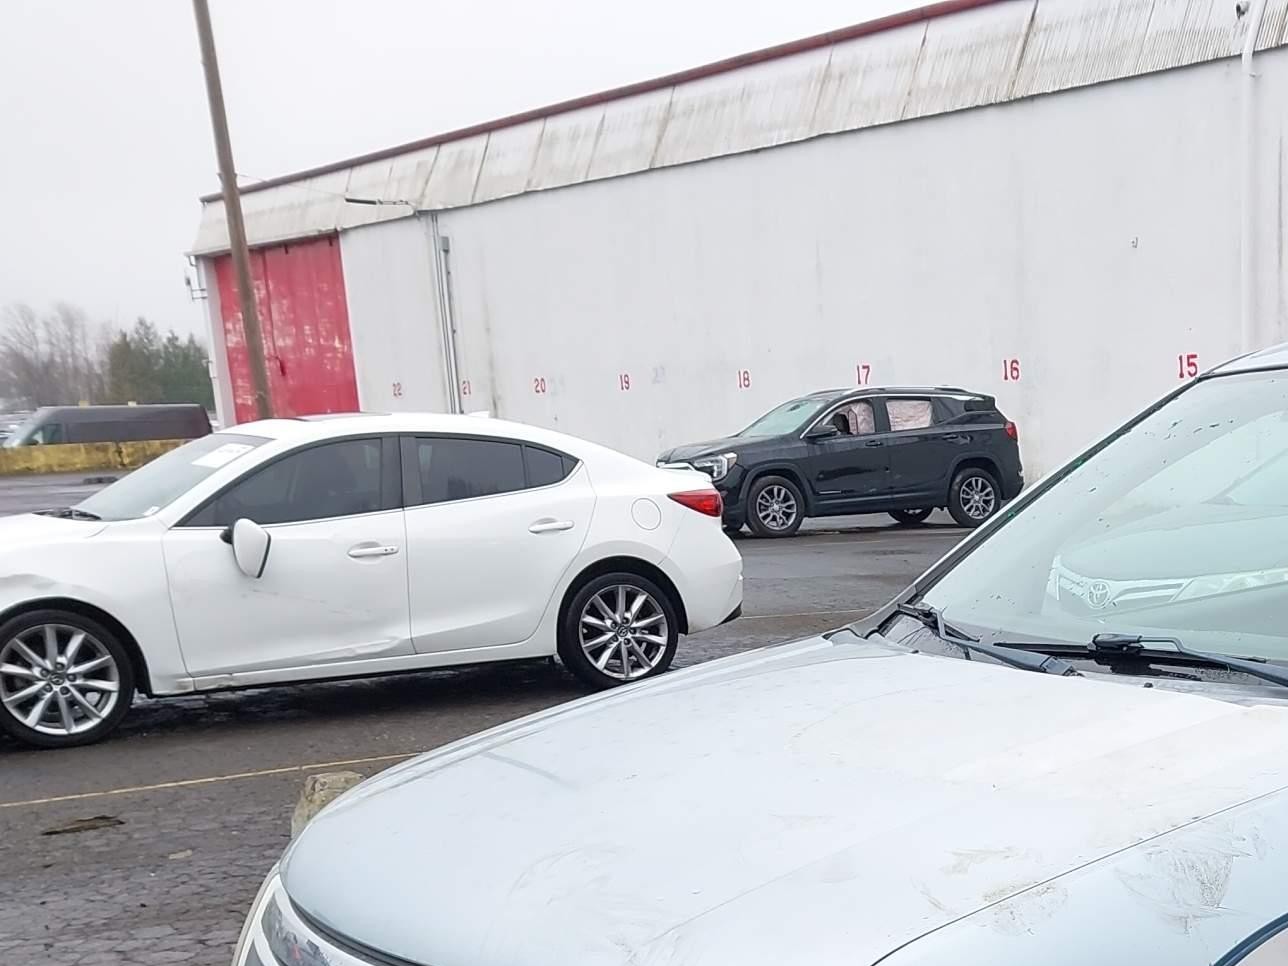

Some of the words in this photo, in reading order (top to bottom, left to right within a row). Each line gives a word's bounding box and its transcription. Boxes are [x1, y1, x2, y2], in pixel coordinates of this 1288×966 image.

[856, 364, 870, 385] 17
[1003, 359, 1020, 380] 16
[1178, 354, 1198, 378] 15
[534, 378, 546, 393] 20
[619, 374, 630, 390] 19
[738, 370, 750, 389] 18
